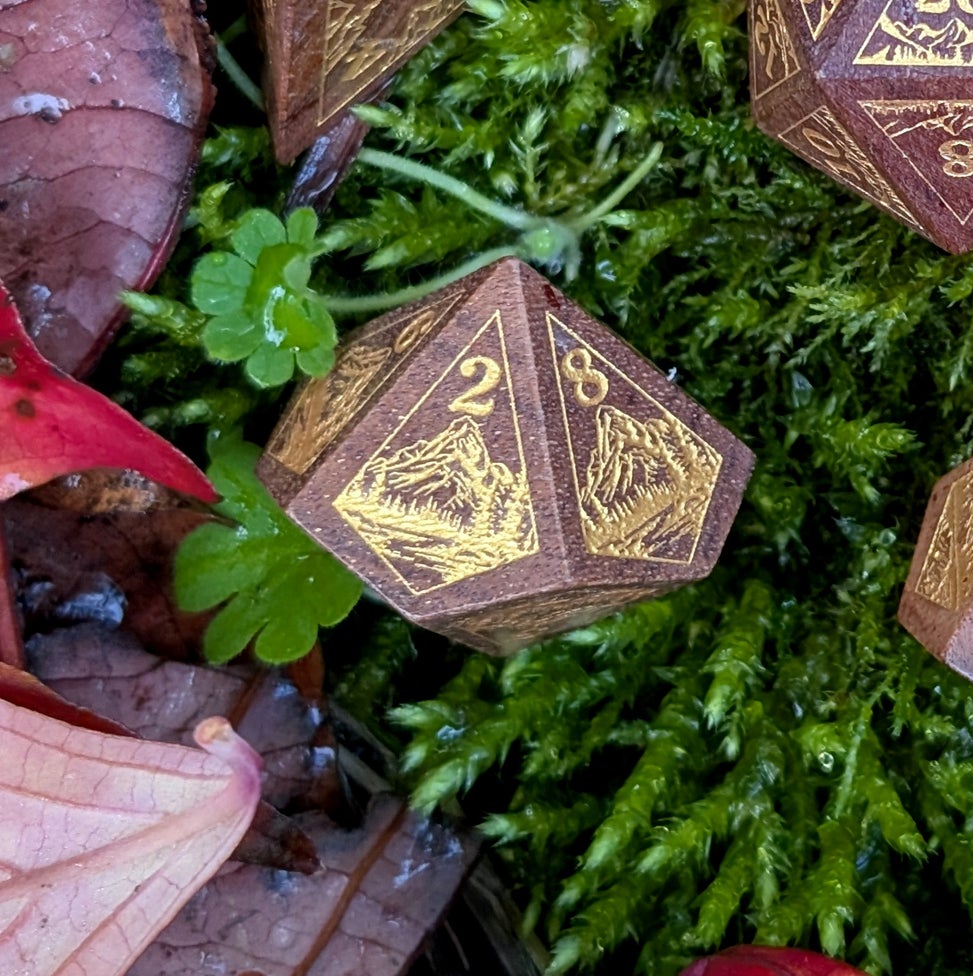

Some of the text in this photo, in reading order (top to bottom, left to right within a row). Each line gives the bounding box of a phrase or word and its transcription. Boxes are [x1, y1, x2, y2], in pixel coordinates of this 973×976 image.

[802, 127, 862, 181] 10
[448, 354, 502, 417] 2
[561, 347, 609, 408] 8
